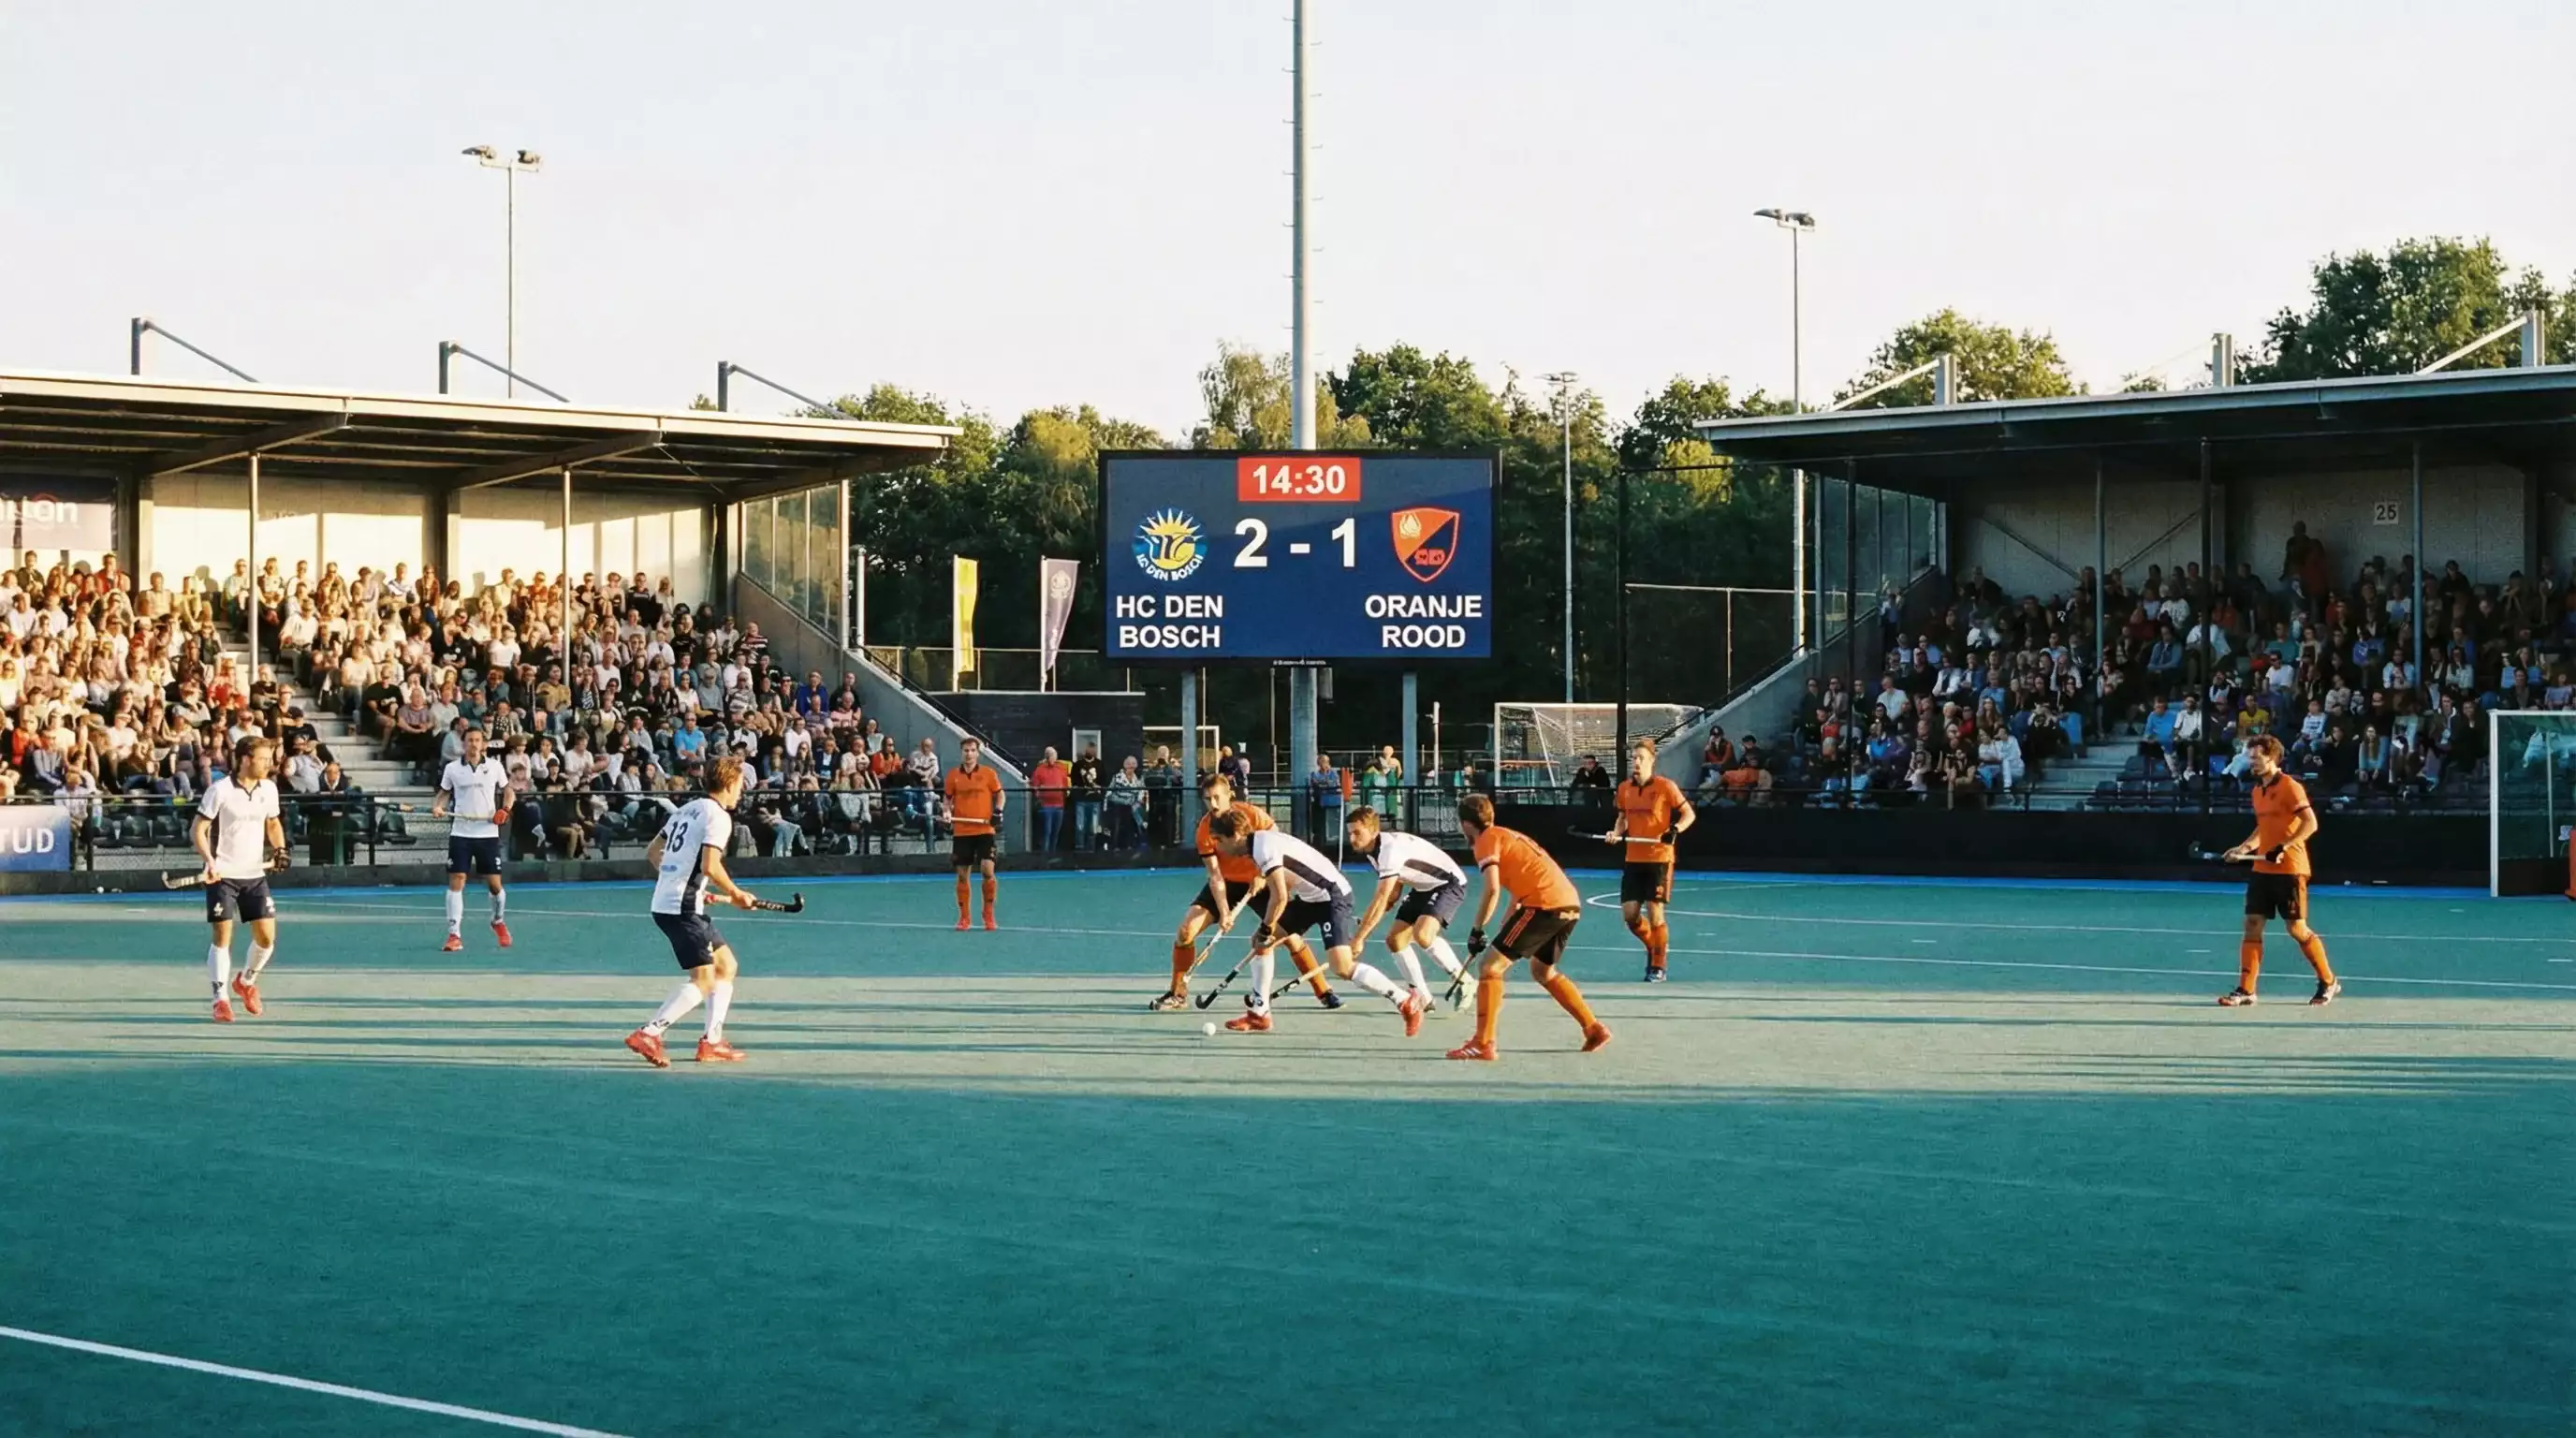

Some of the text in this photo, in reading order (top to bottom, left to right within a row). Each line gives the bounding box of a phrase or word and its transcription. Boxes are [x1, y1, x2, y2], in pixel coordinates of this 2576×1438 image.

[1252, 464, 1346, 494] 14:30
[1234, 518, 1354, 567] 2 - 1
[1117, 594, 1223, 618] HC DEN
[1365, 594, 1483, 618] ORANJE
[1120, 624, 1221, 648] BOSCH
[1383, 624, 1467, 648] ROOD
[666, 822, 688, 852] 13
